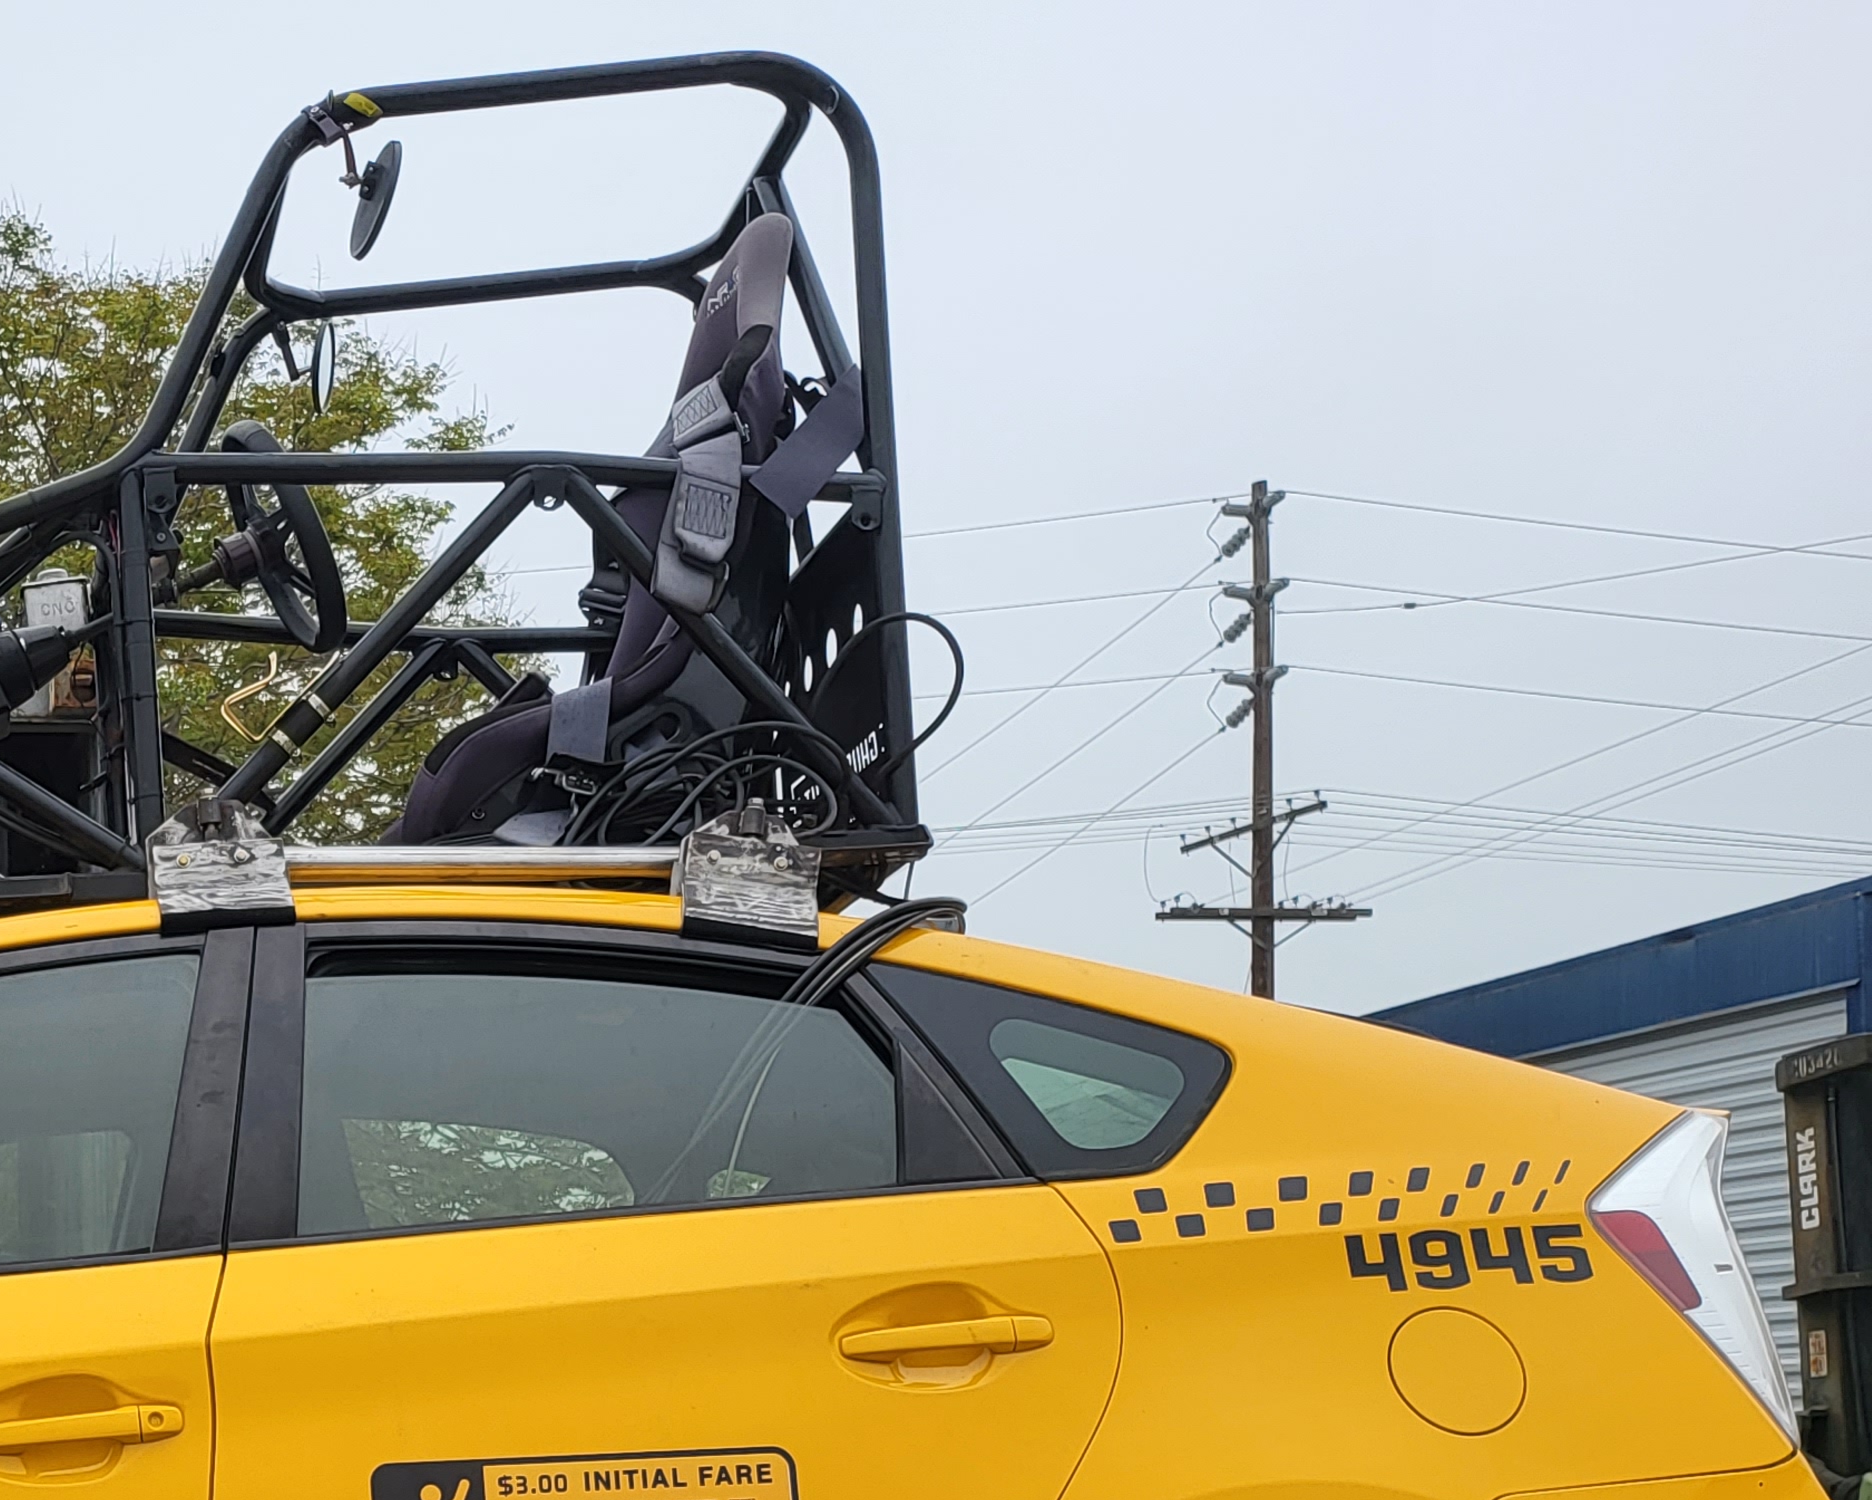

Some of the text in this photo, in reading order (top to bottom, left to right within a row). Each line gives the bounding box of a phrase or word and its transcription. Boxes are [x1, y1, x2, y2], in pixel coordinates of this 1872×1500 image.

[1795, 1127, 1821, 1231] CLARK
[1344, 1224, 1594, 1292] 4945
[498, 1463, 773, 1496] $3.00 INITIAL FARE
